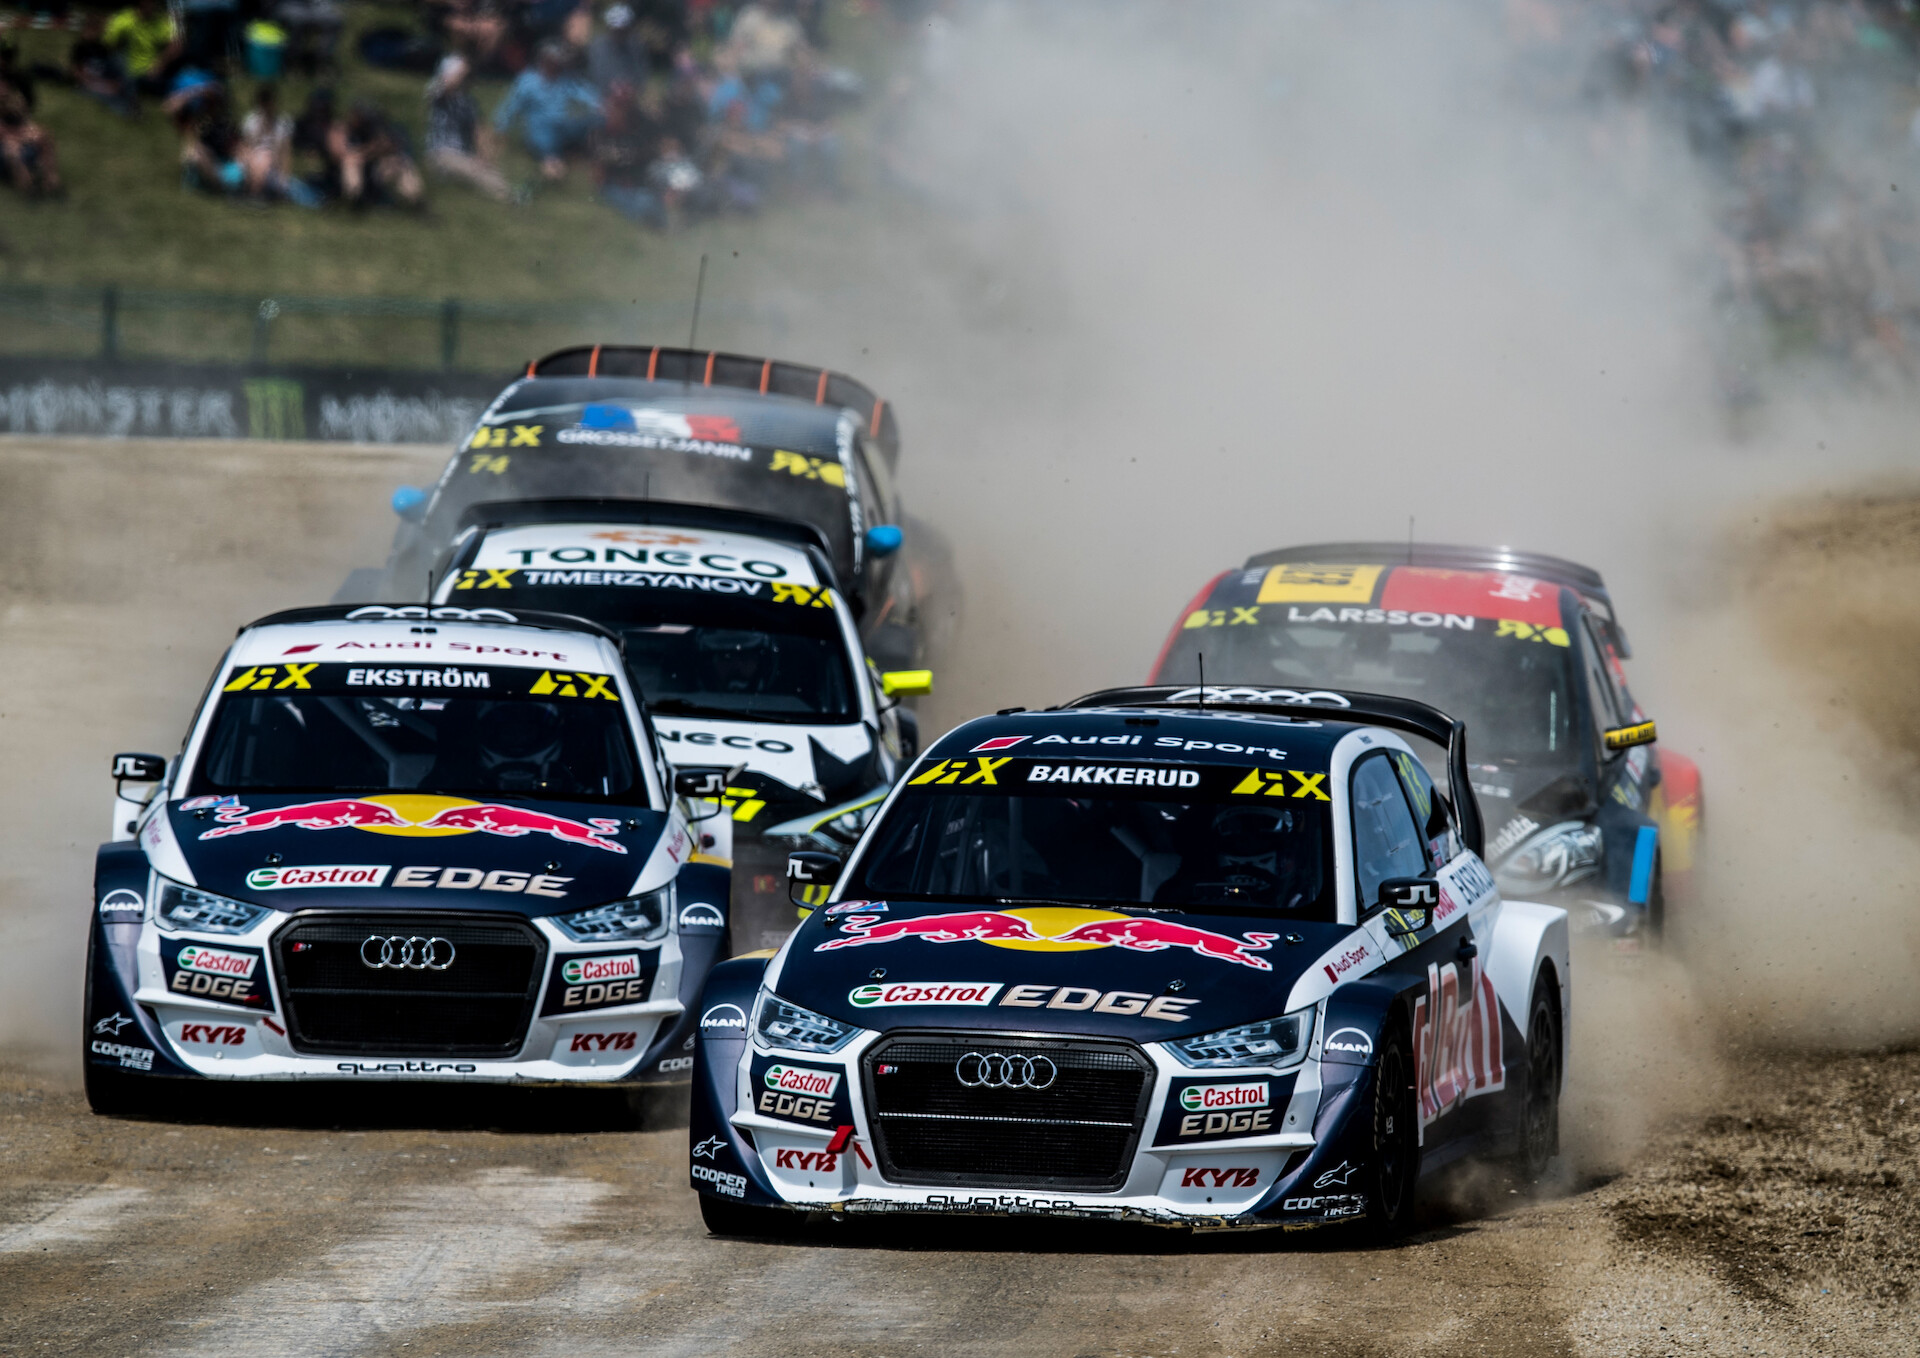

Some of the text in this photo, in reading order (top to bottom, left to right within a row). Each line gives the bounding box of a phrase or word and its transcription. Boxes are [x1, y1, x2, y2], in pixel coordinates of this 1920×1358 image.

[320, 392, 476, 441] MONS
[524, 570, 763, 596] TIMERZYANOV
[1287, 606, 1475, 630] LARSSON
[449, 642, 568, 662] Sport
[346, 667, 491, 688] EKSTRÖM
[655, 730, 794, 754] NECO
[1032, 734, 1288, 761] Audi Sport
[1027, 765, 1200, 788] BAKKERUD
[281, 866, 575, 897] Castrol EDGE
[103, 901, 141, 912] MAN
[682, 914, 721, 926] MAN
[195, 950, 252, 975] Castrol
[583, 958, 636, 980] Castrol
[171, 971, 255, 999] EDGE
[563, 979, 643, 1006] EDGE
[884, 984, 1201, 1023] Castrol EDGE
[704, 1017, 742, 1028] MAN
[181, 1023, 247, 1046] KYB
[570, 1031, 638, 1052] KYB
[91, 1041, 154, 1062] COOPER
[1329, 1042, 1369, 1053] MAN
[118, 1057, 153, 1071] TIRES
[337, 1061, 476, 1075] quattro
[659, 1056, 694, 1072] COO
[780, 1067, 834, 1095] Castrol
[759, 1091, 836, 1122] EDGE
[1203, 1085, 1265, 1108] Castrol
[1179, 1109, 1274, 1137] EDGE
[776, 1149, 837, 1172] KYB
[692, 1164, 747, 1188] COOPER
[1181, 1167, 1260, 1188] KYB
[716, 1183, 745, 1199] TIRES
